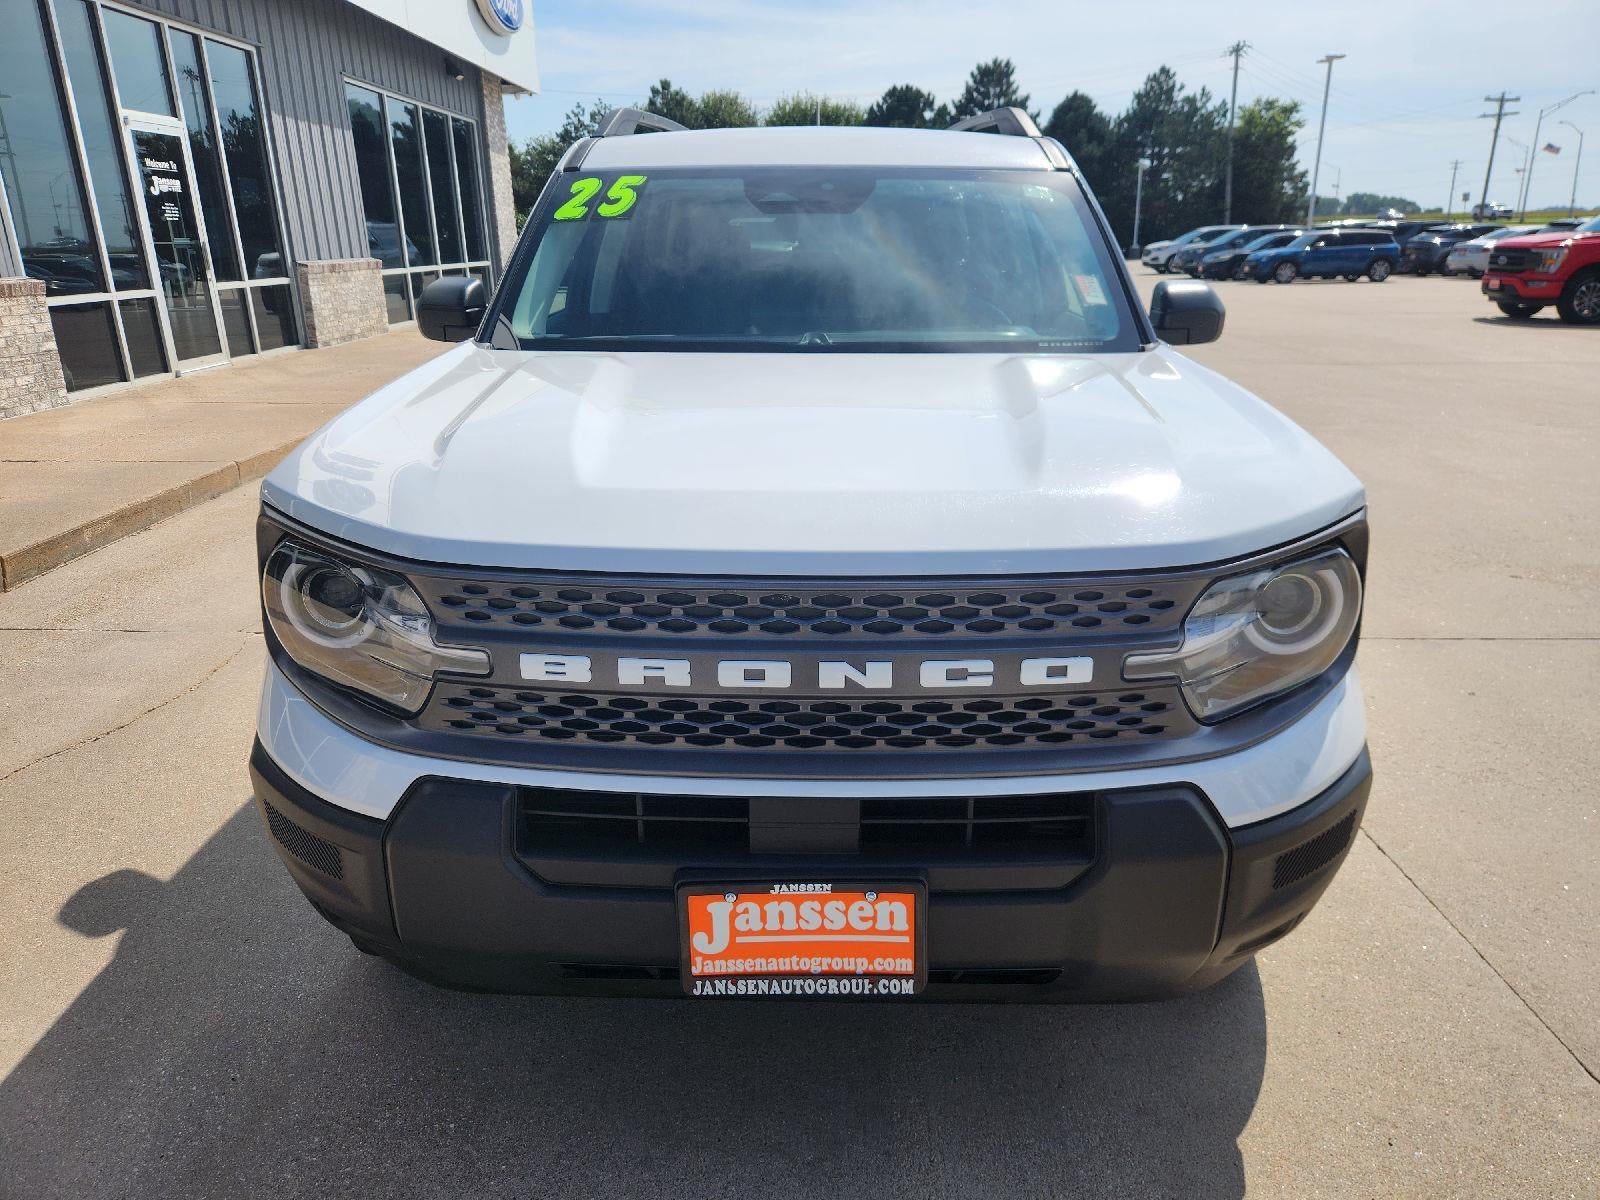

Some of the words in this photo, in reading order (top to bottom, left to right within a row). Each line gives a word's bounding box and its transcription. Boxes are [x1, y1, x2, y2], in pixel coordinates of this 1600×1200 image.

[145, 157, 170, 170] Welcome
[169, 161, 177, 170] To
[554, 175, 647, 220] 25
[519, 653, 1094, 688] BRONCO
[770, 884, 832, 894] JANSSEN
[693, 901, 909, 954] Janssen
[692, 956, 913, 974] Janssenautogroup.com
